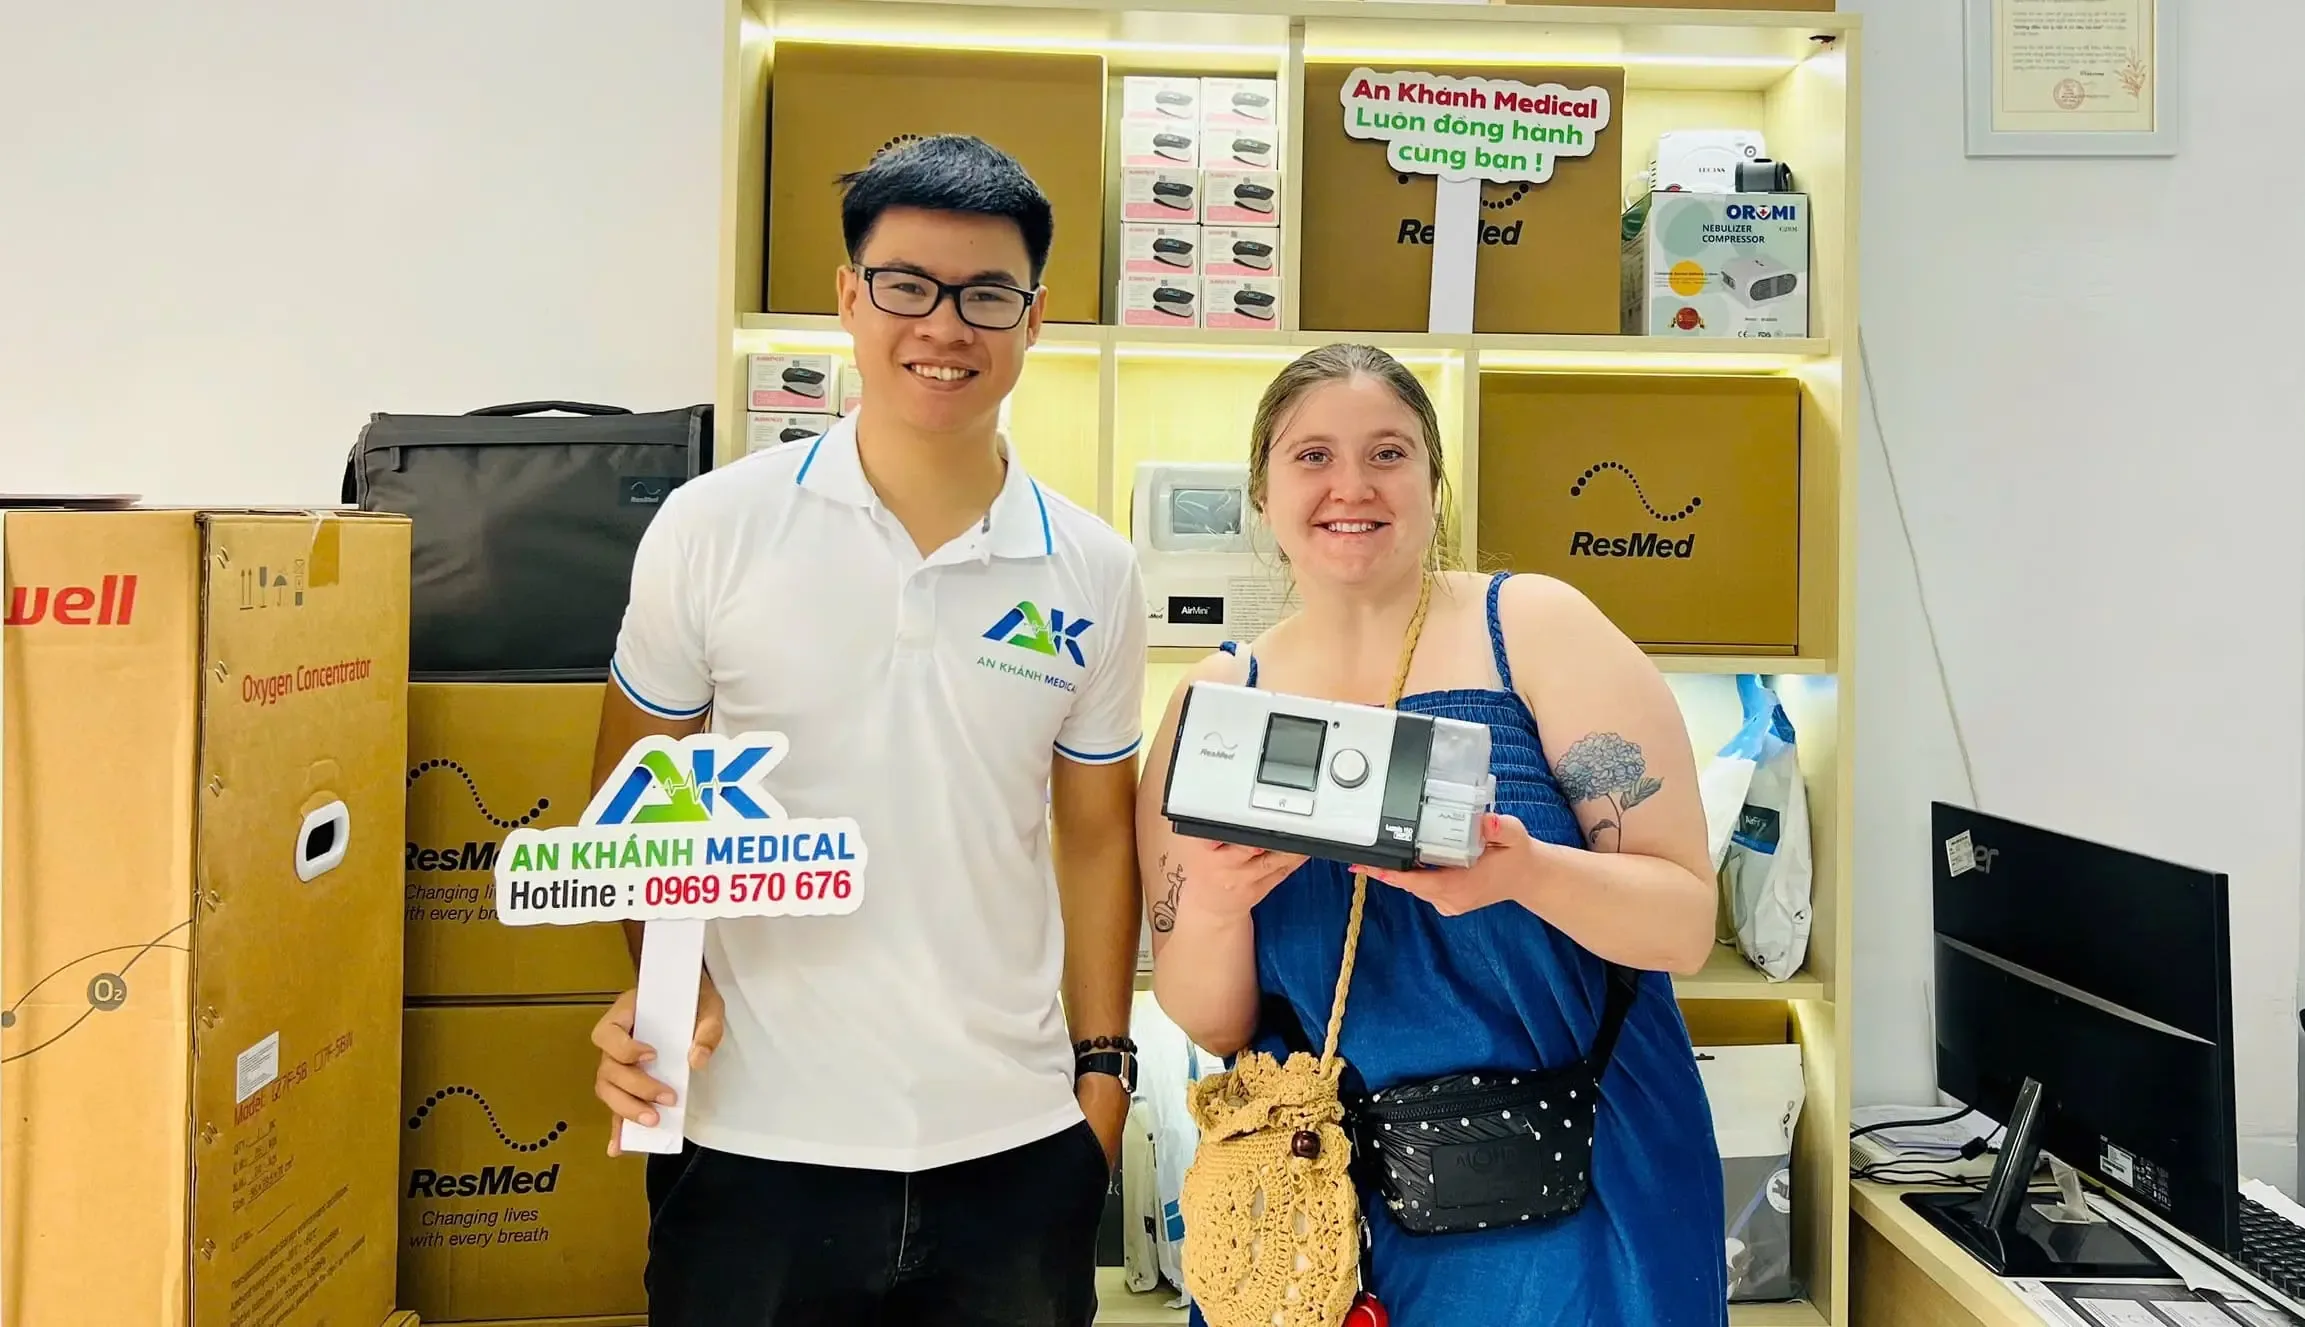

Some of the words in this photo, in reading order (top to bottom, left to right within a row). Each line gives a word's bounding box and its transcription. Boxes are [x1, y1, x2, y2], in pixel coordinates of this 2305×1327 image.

[1352, 79, 1391, 101] An
[1400, 83, 1486, 109] Khánh
[1495, 91, 1598, 119] Medical
[1475, 147, 1527, 173] bạn
[1726, 204, 1796, 220] OROMI
[1397, 219, 1523, 245] Reed
[1702, 224, 1752, 233] NEBULIZER
[1702, 234, 1765, 244] COMPRESSOR
[1569, 531, 1696, 558] ResMed
[243, 671, 293, 706] Oxygen
[297, 658, 372, 693] Concentrator
[977, 656, 996, 669] AN
[1000, 662, 1041, 682] KHÁNH
[509, 843, 560, 872] AN
[571, 833, 694, 871] KHÁNH
[705, 832, 856, 865] MEDICAL
[510, 879, 616, 910] Hotline
[645, 874, 720, 906] 0969
[730, 872, 786, 902] 570
[795, 870, 852, 900] 676
[430, 910, 474, 924] every
[407, 1163, 560, 1198] ResMed
[422, 1209, 498, 1228] Changing
[503, 1208, 538, 1223] lives
[410, 1232, 443, 1248] with
[450, 1232, 492, 1248] every
[497, 1228, 549, 1244] breath
